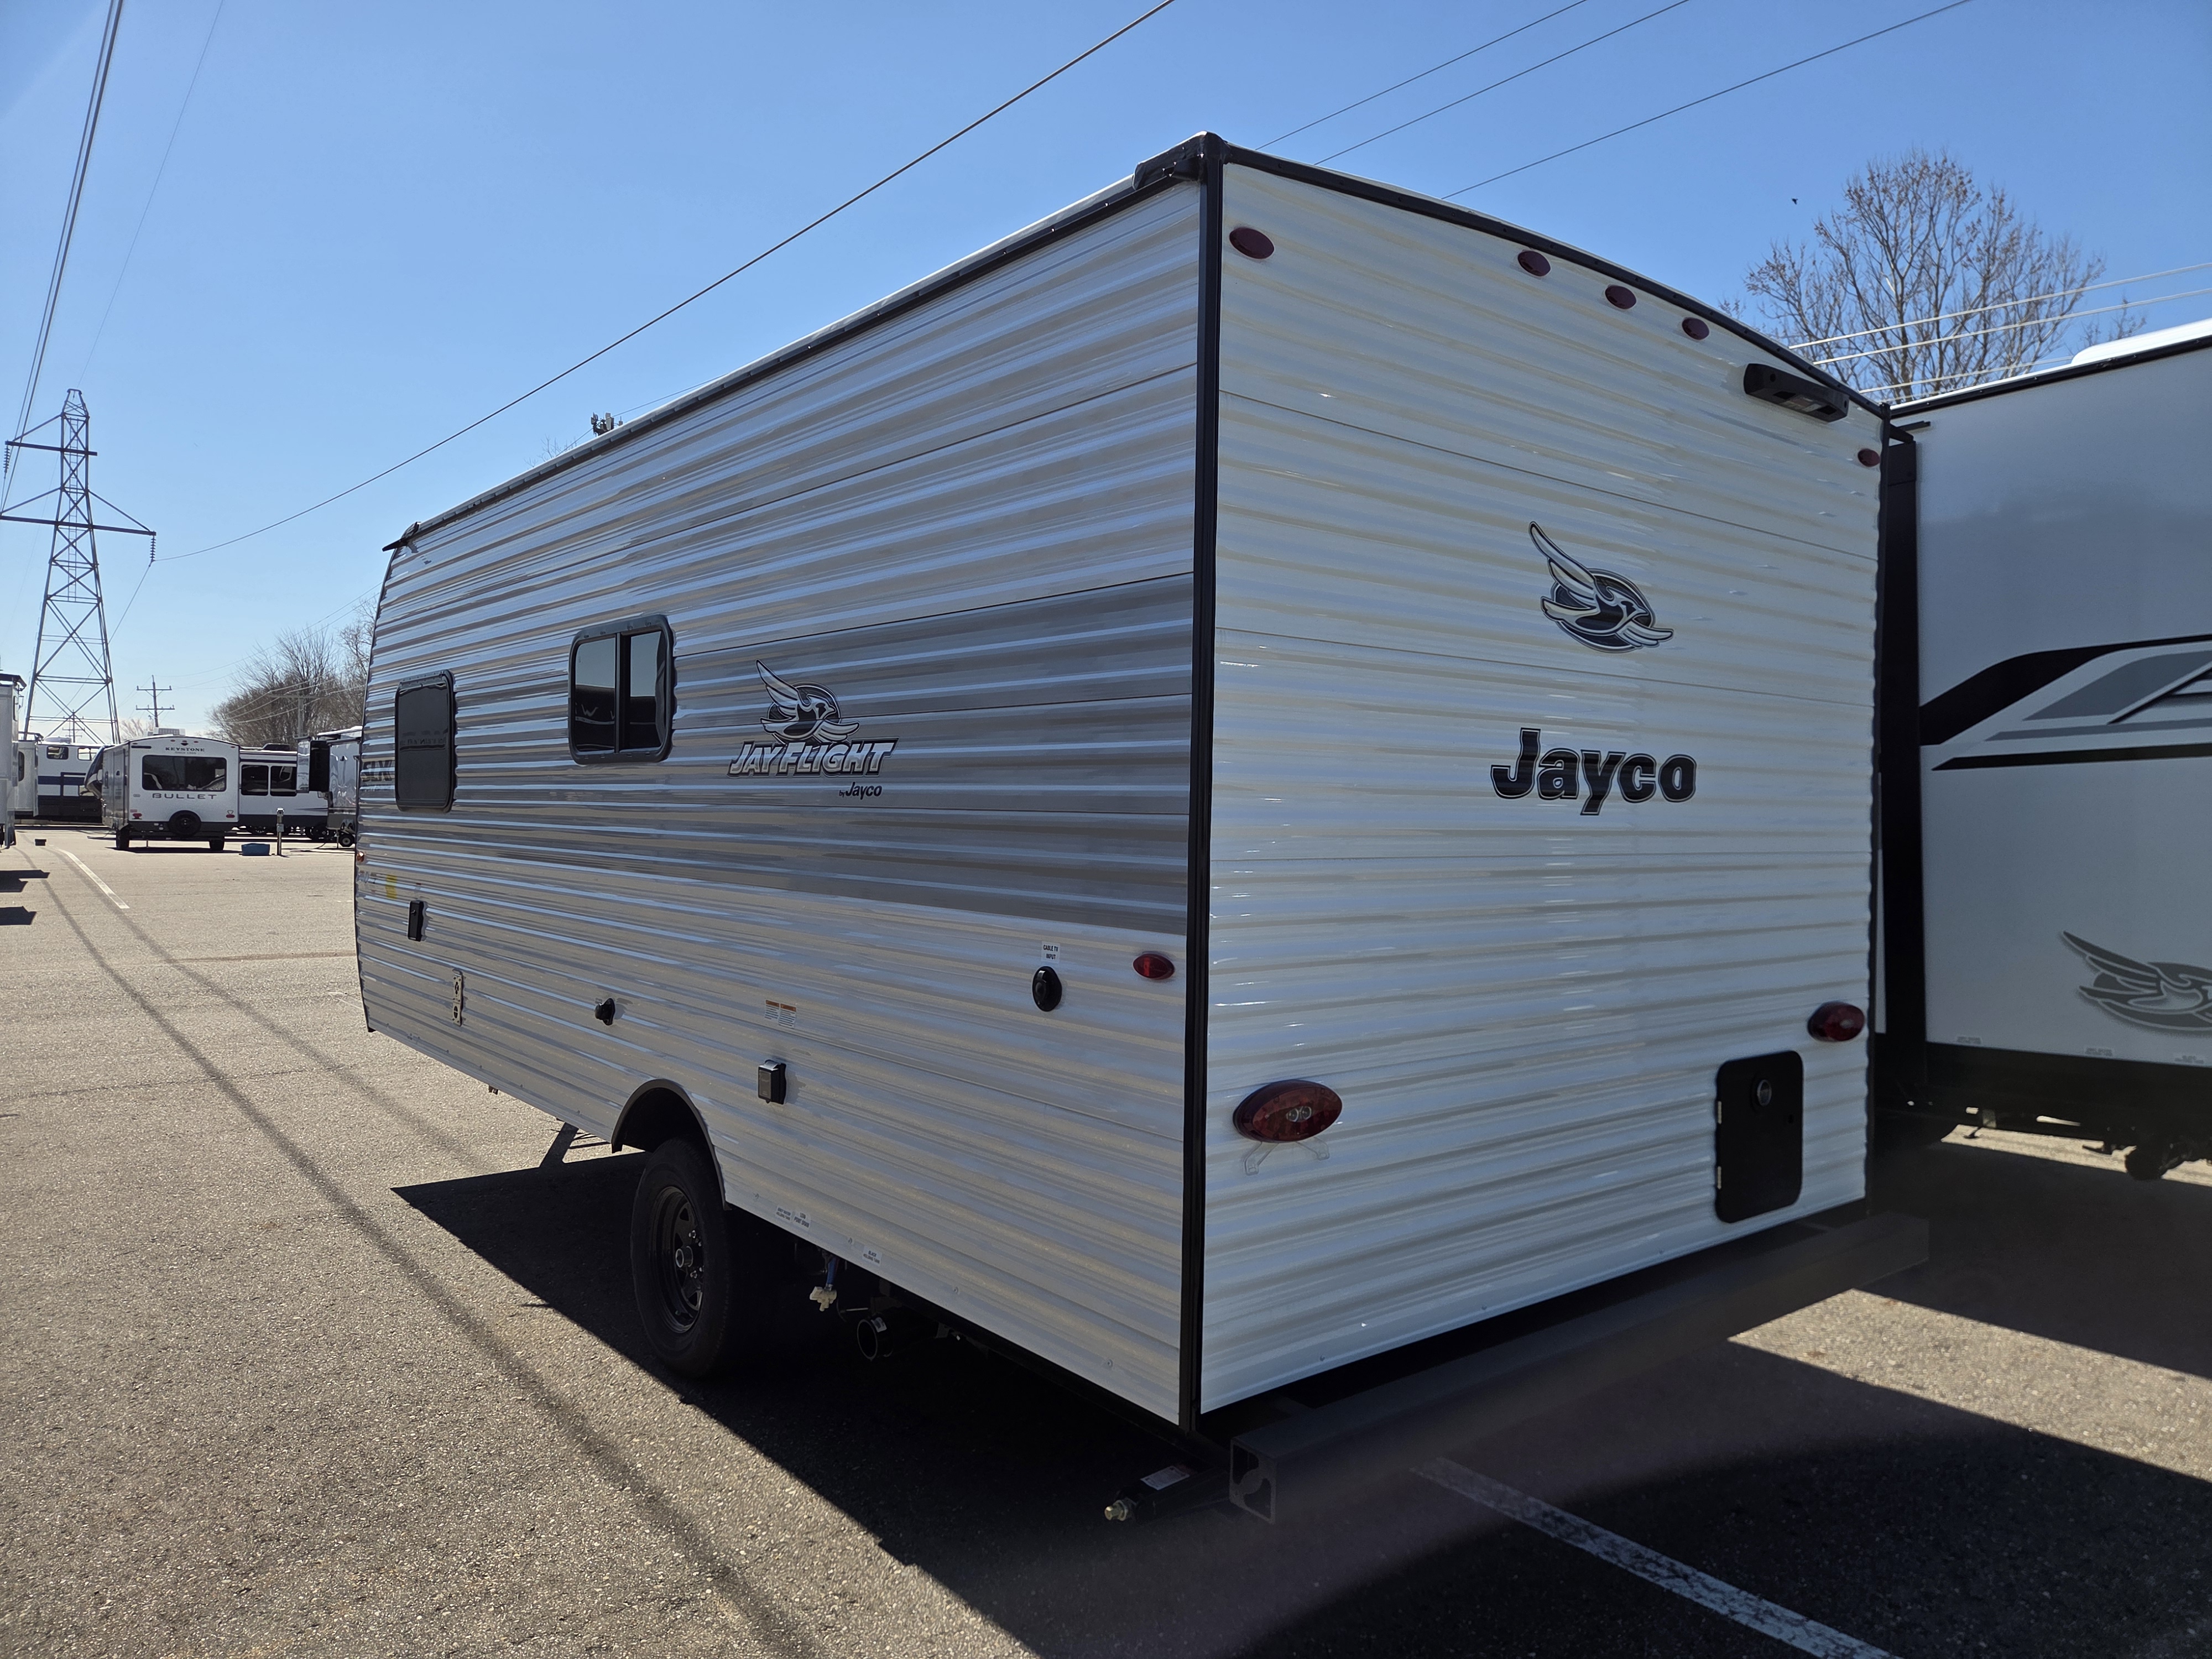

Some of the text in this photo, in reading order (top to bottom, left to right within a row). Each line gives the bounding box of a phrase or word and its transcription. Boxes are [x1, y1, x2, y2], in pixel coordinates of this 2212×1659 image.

[362, 760, 393, 782] SLX
[1490, 727, 1697, 816] Jayco
[845, 782, 883, 800] Jayco
